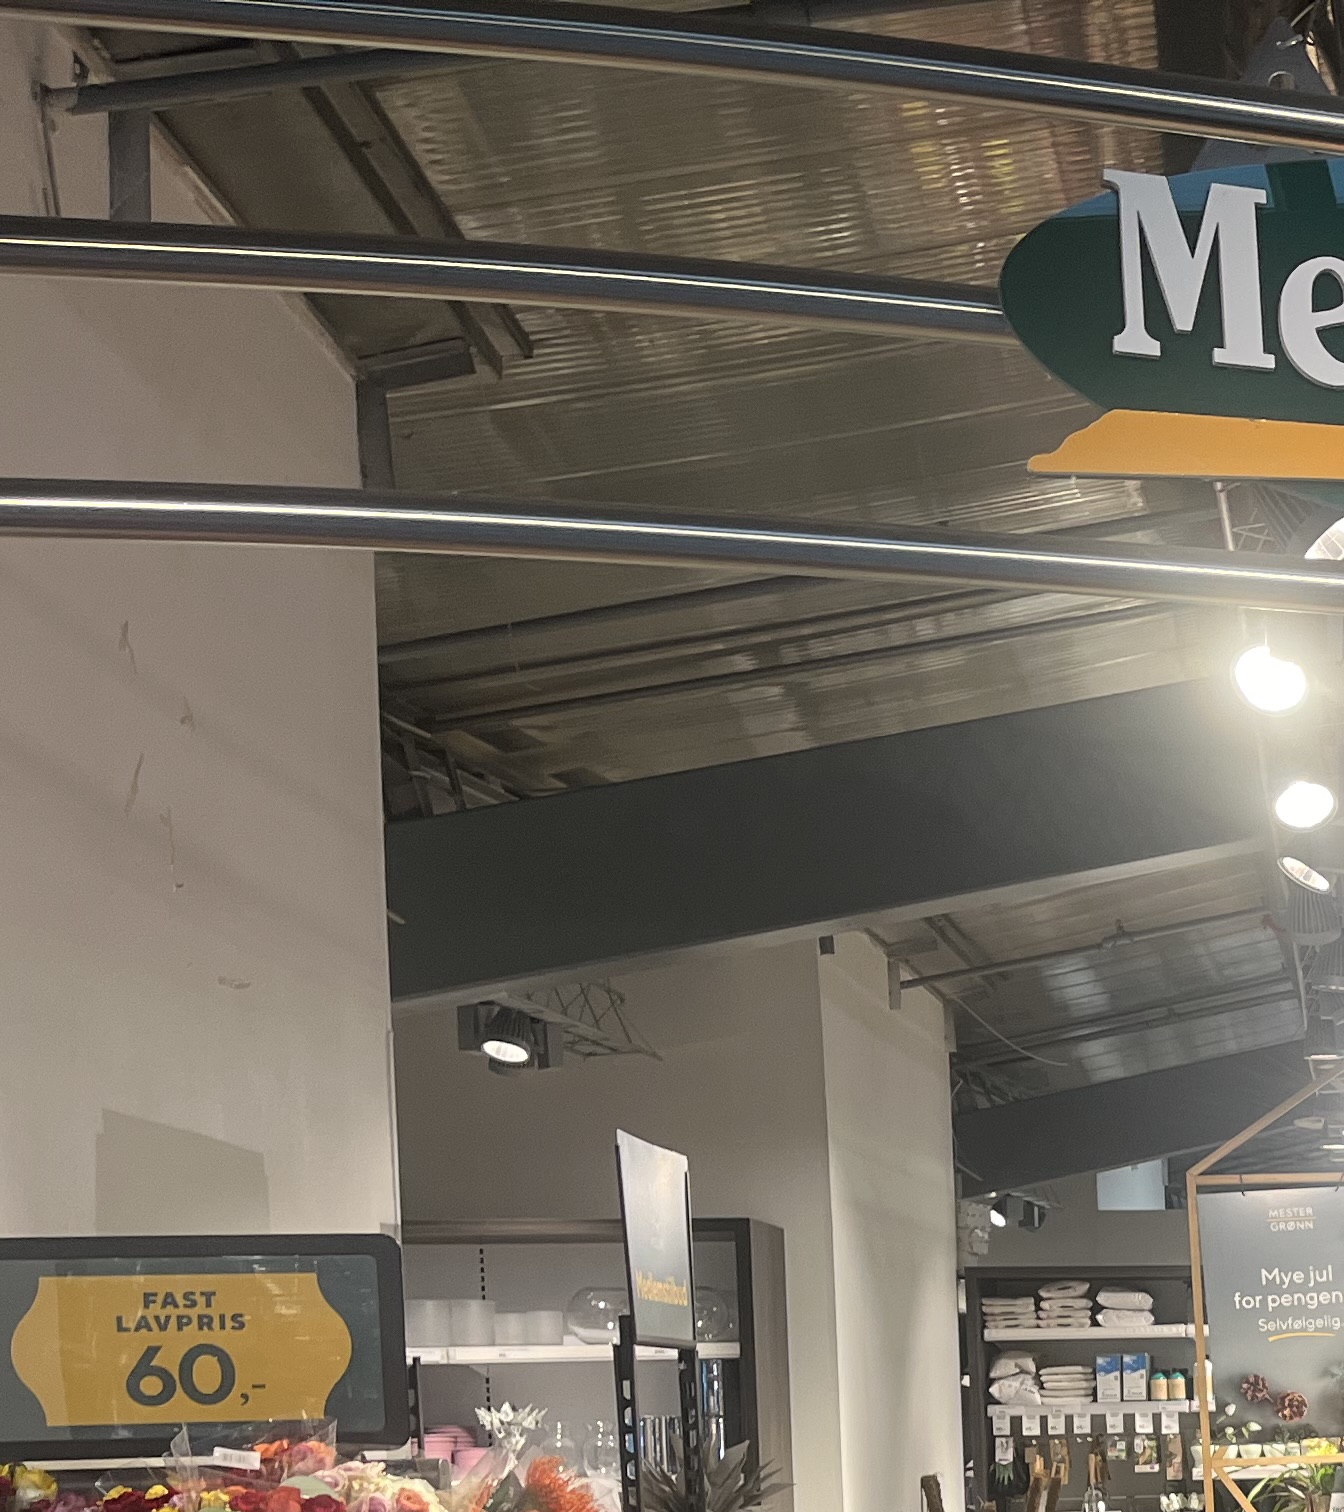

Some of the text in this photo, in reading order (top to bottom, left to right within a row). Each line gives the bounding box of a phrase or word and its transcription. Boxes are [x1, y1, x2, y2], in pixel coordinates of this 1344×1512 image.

[1268, 1207, 1314, 1219] MESTER
[1269, 1220, 1314, 1232] GRØNN
[1260, 1265, 1333, 1289] Mye jul
[143, 1291, 217, 1310] FAST
[1234, 1291, 1263, 1310] for
[116, 1313, 247, 1333] LAVPRIS
[1258, 1314, 1344, 1333] Selvfølgelig.
[126, 1343, 266, 1407] 60,-
